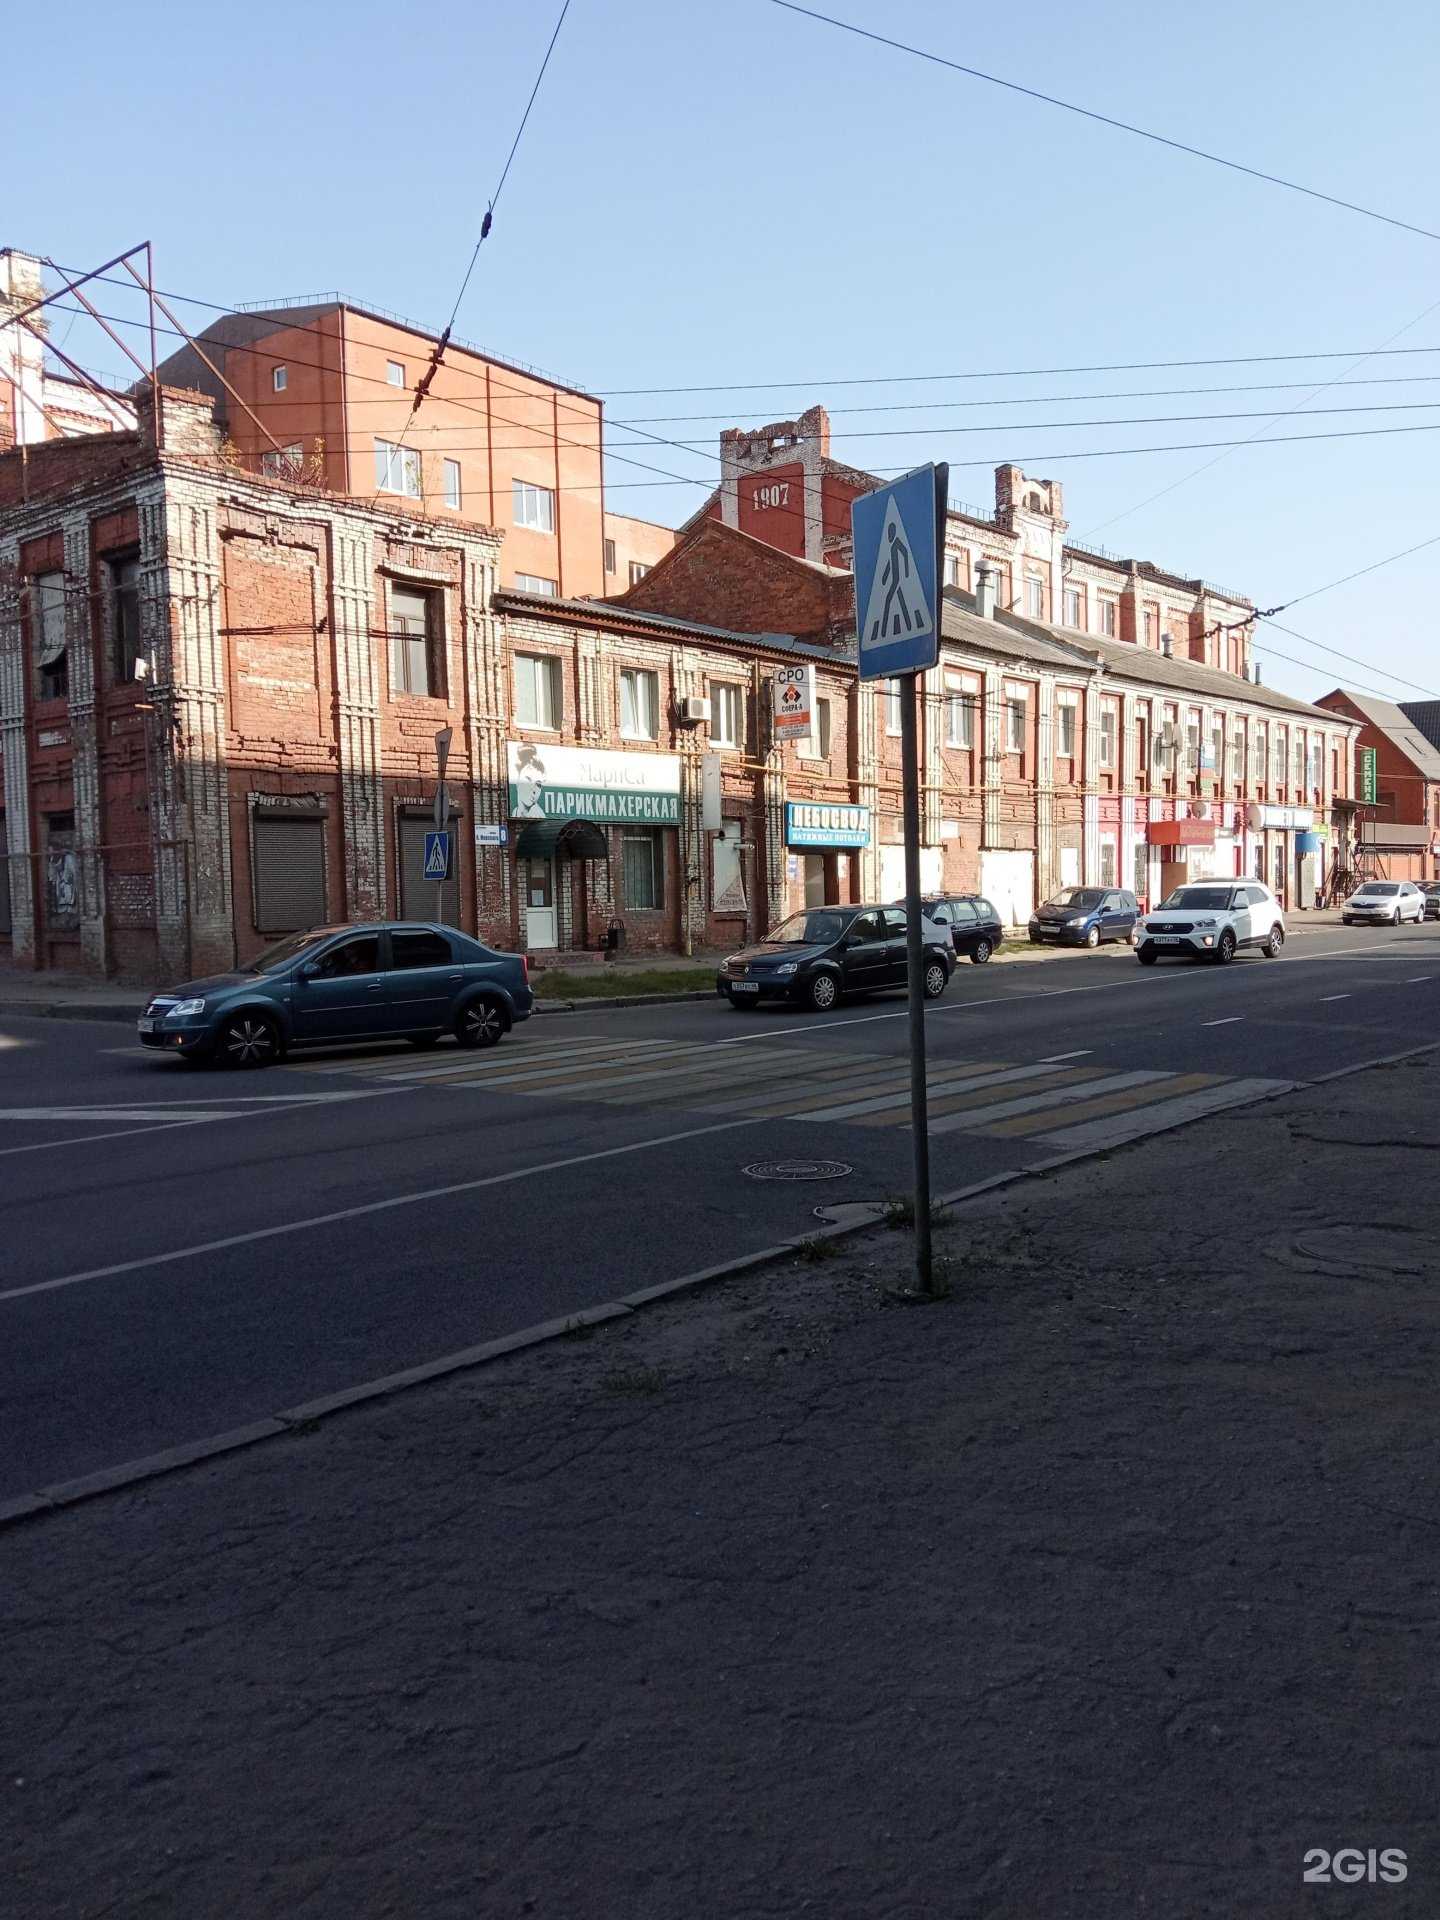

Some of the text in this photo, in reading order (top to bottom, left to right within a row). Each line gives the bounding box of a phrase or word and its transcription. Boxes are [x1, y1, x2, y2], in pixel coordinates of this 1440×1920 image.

[752, 483, 790, 511] 1907
[778, 668, 804, 684] СРО
[1363, 754, 1372, 801] СЕМЕНА
[544, 791, 678, 819] ПАРИКМАХЕРСКАЯ
[791, 805, 868, 832] НЕБОСВОД
